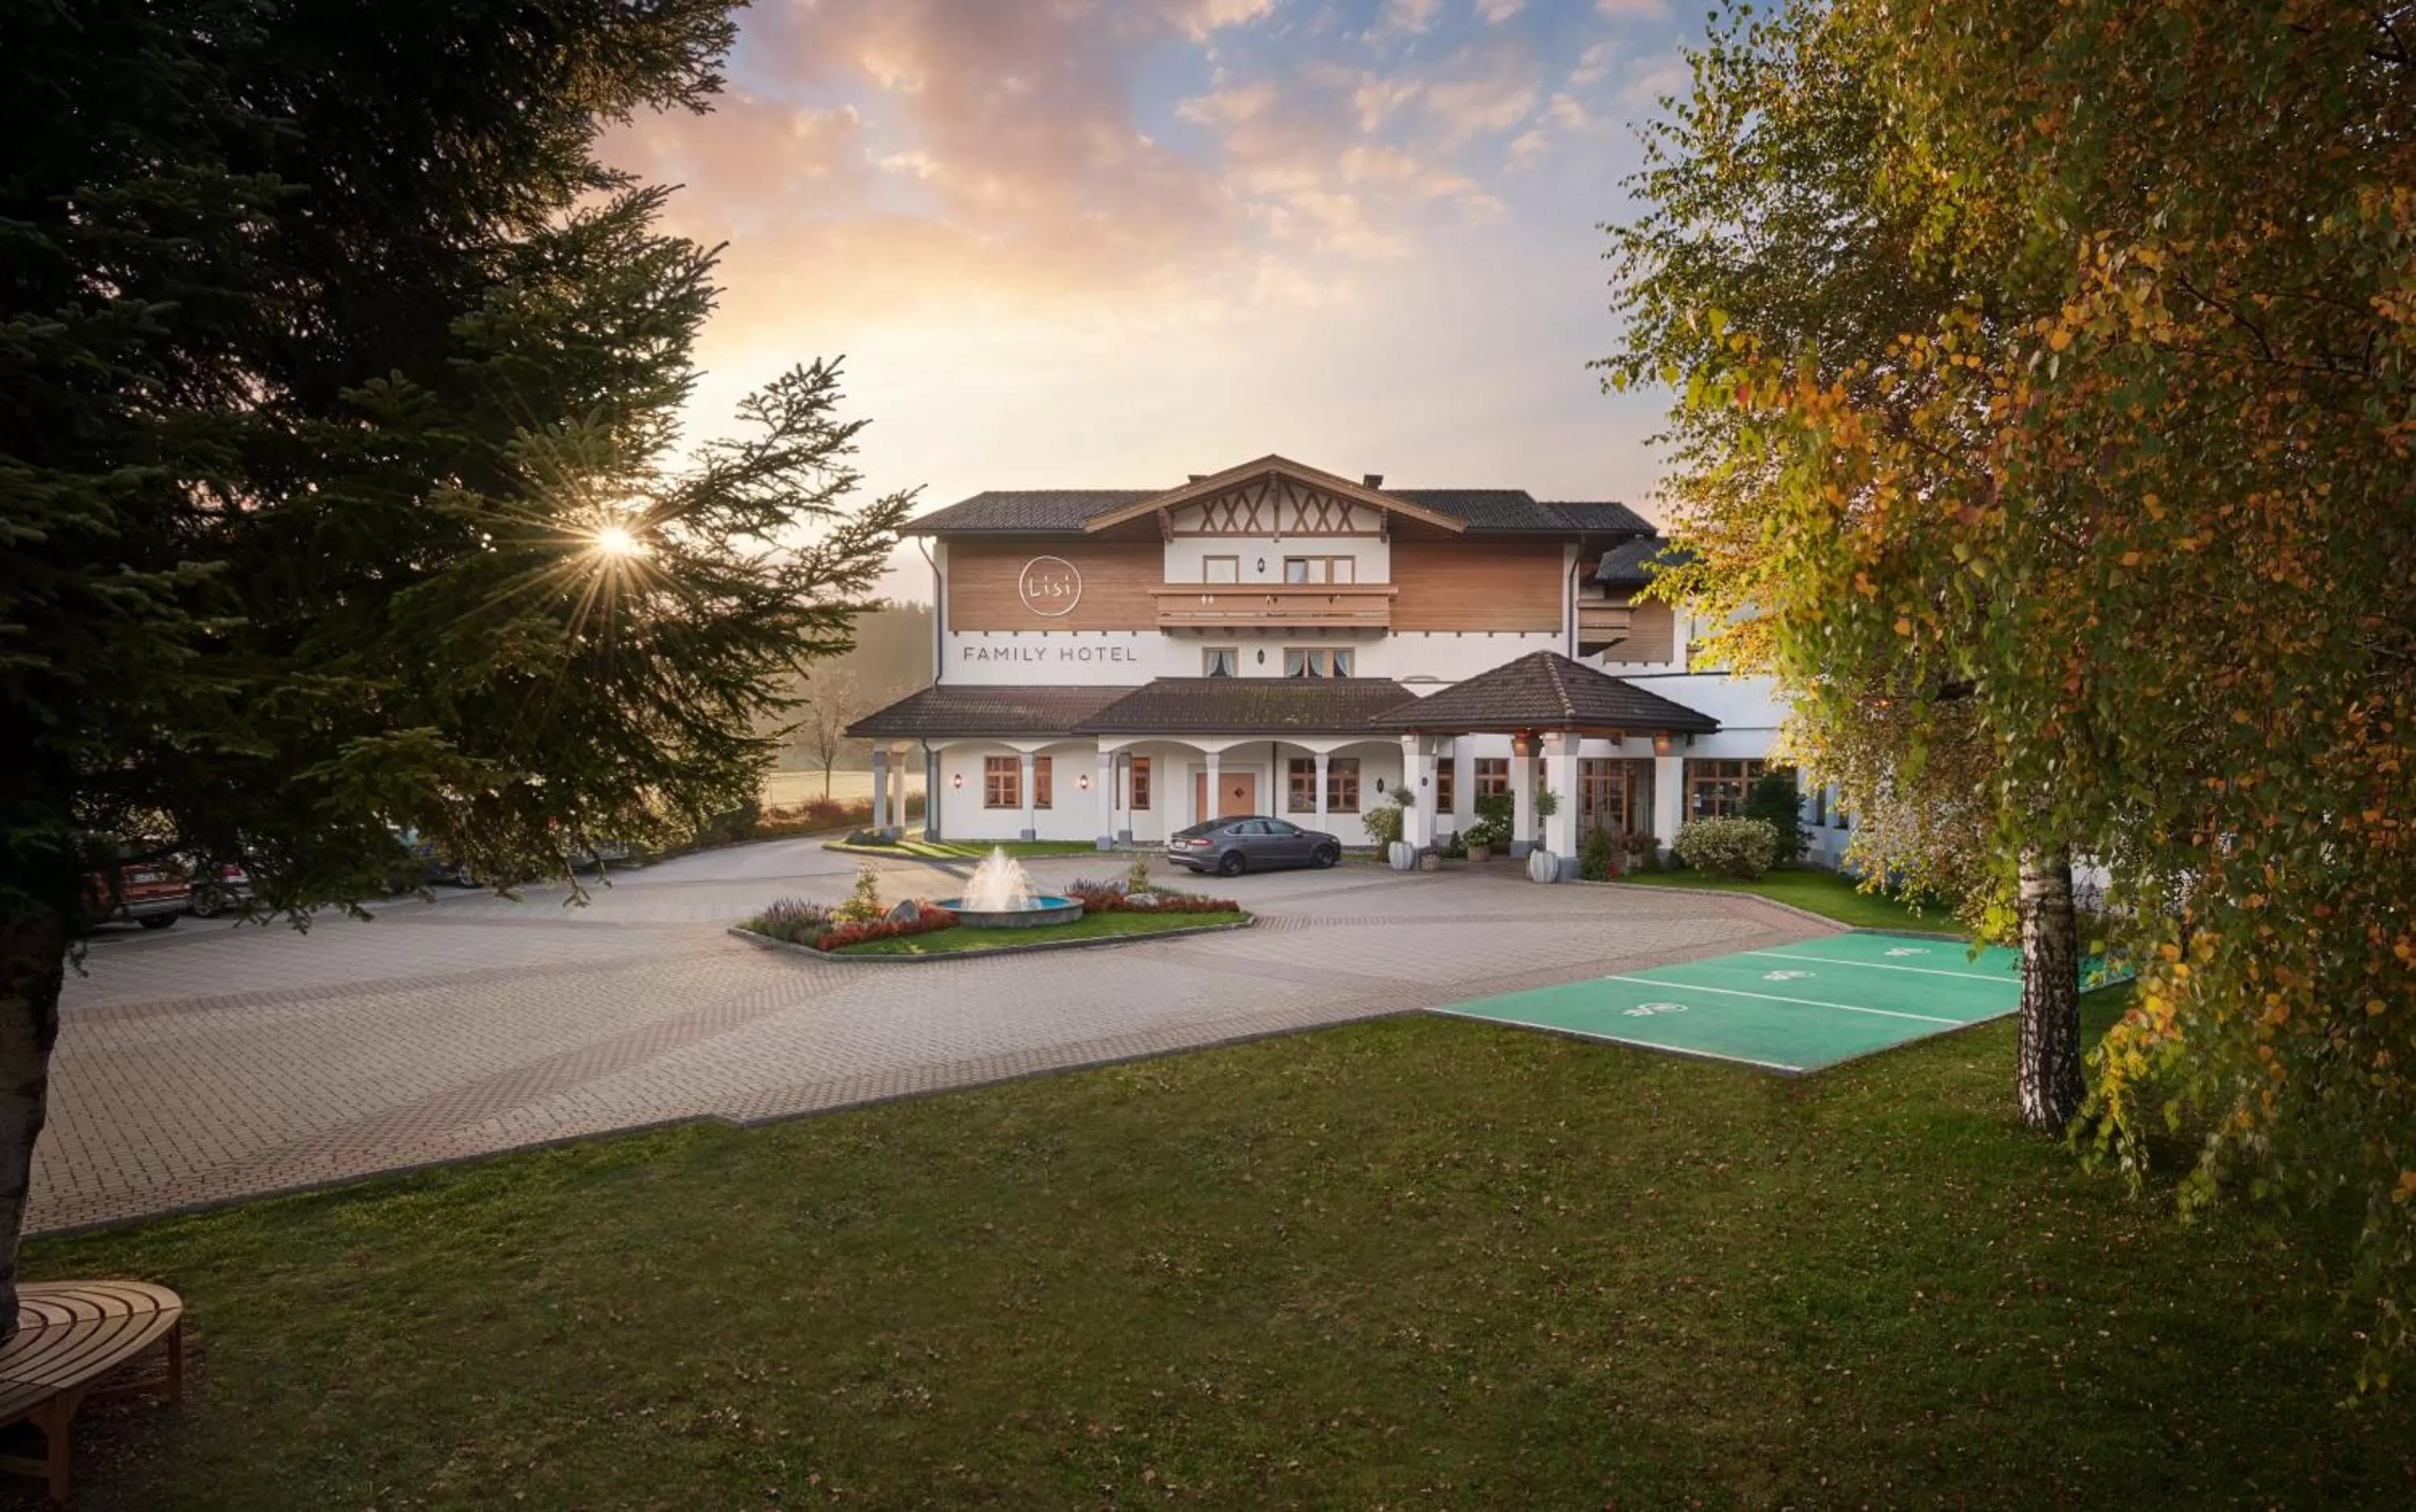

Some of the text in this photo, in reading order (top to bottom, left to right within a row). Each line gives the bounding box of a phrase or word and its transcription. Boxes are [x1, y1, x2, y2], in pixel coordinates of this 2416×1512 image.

[1028, 575, 1070, 597] Lisi
[963, 647, 1137, 661] FAMILY HOTEL
